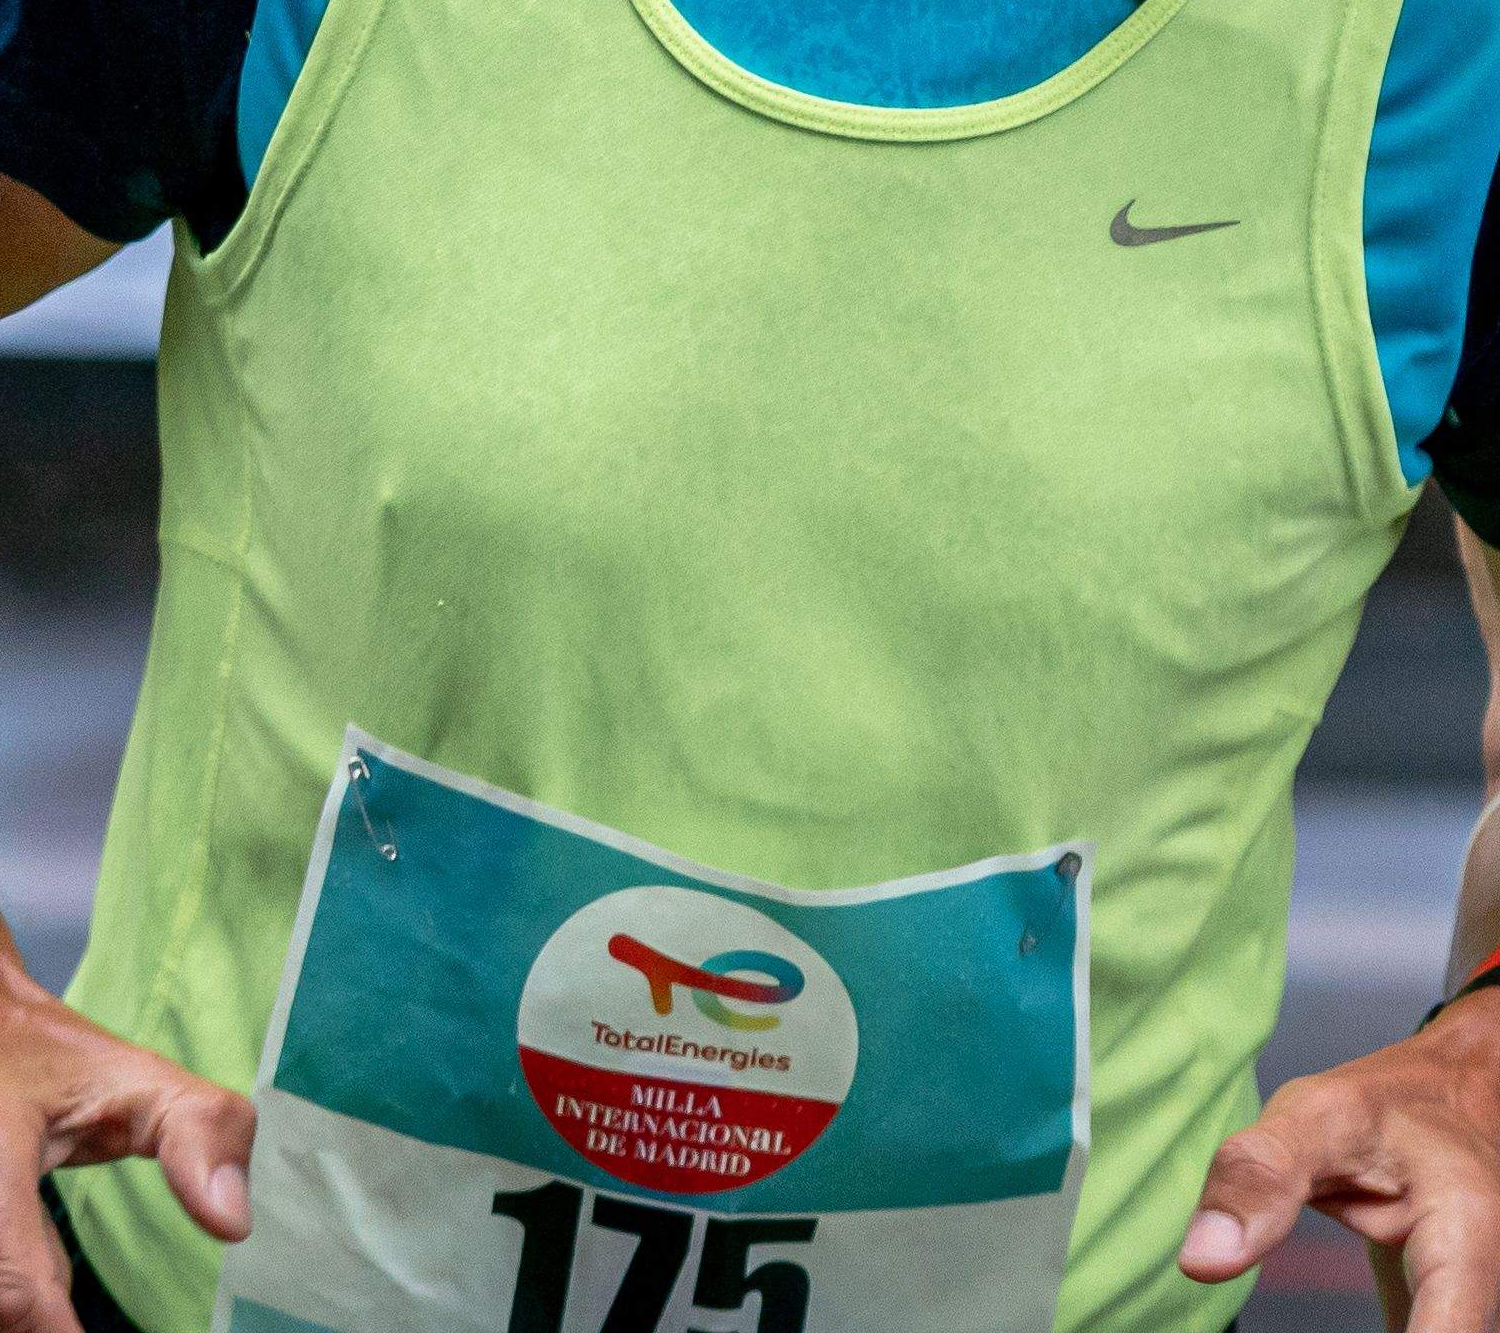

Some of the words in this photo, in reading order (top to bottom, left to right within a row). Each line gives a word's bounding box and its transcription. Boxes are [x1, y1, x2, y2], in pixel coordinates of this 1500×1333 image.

[590, 1020, 793, 1072] TotalEnergies
[631, 1084, 722, 1118] MILLA
[586, 1128, 627, 1157] DE
[634, 1138, 751, 1177] MADRID
[492, 1180, 819, 1333] 175
